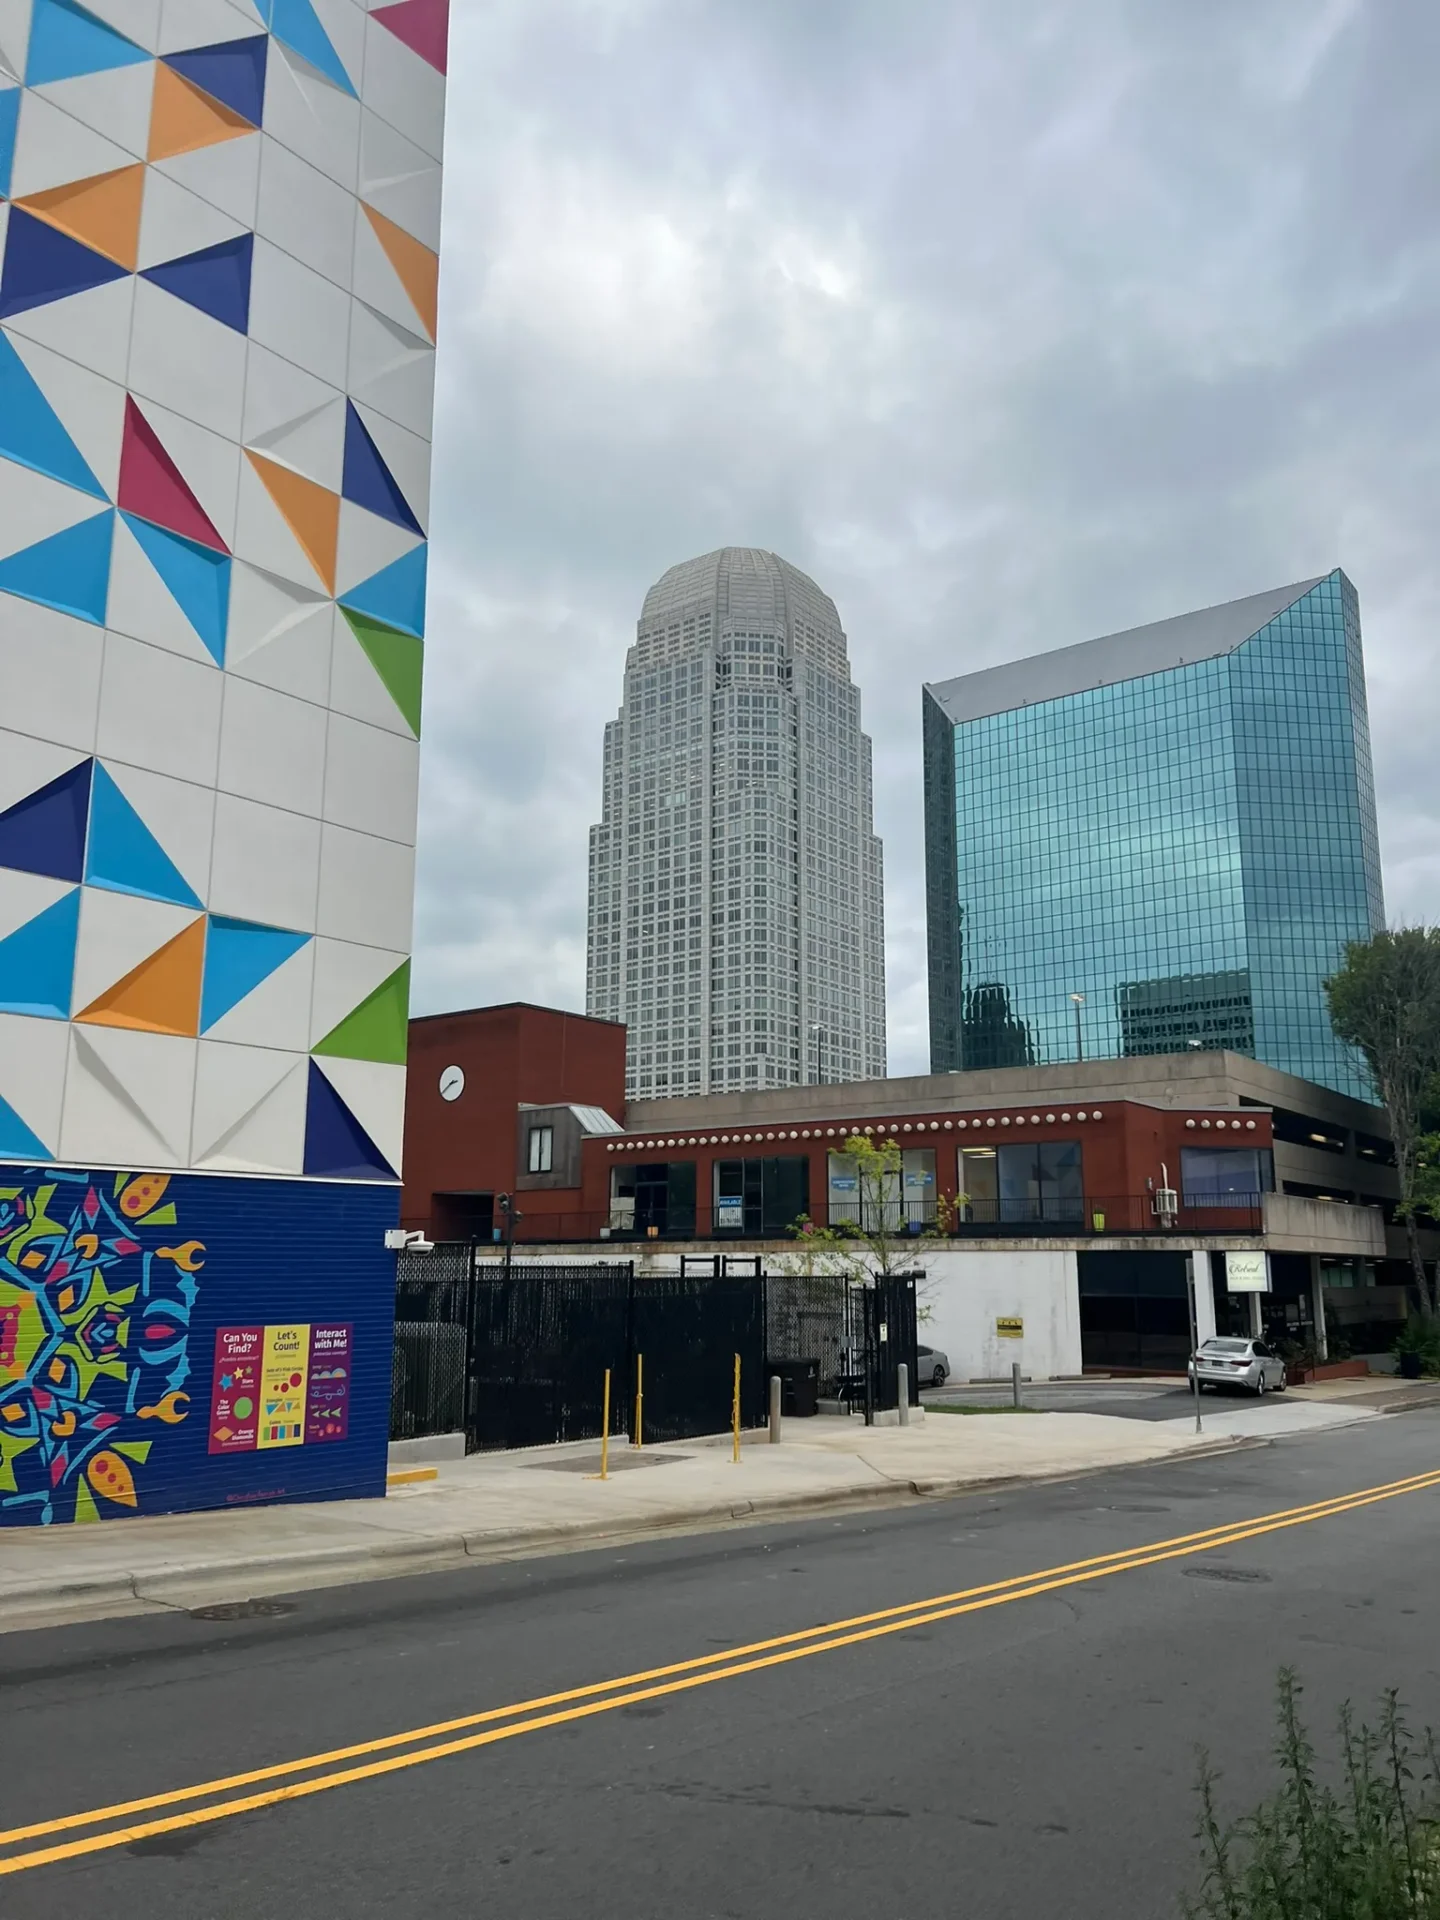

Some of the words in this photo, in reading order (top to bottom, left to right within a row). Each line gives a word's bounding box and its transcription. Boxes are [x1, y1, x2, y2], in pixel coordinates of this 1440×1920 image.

[223, 1333, 240, 1343] Can
[241, 1332, 258, 1342] You
[277, 1331, 297, 1340] Let's
[316, 1329, 347, 1338] Interact
[273, 1341, 300, 1351] Count!
[315, 1339, 332, 1348] with
[333, 1338, 347, 1348] Me!
[228, 1343, 252, 1354] Find?
